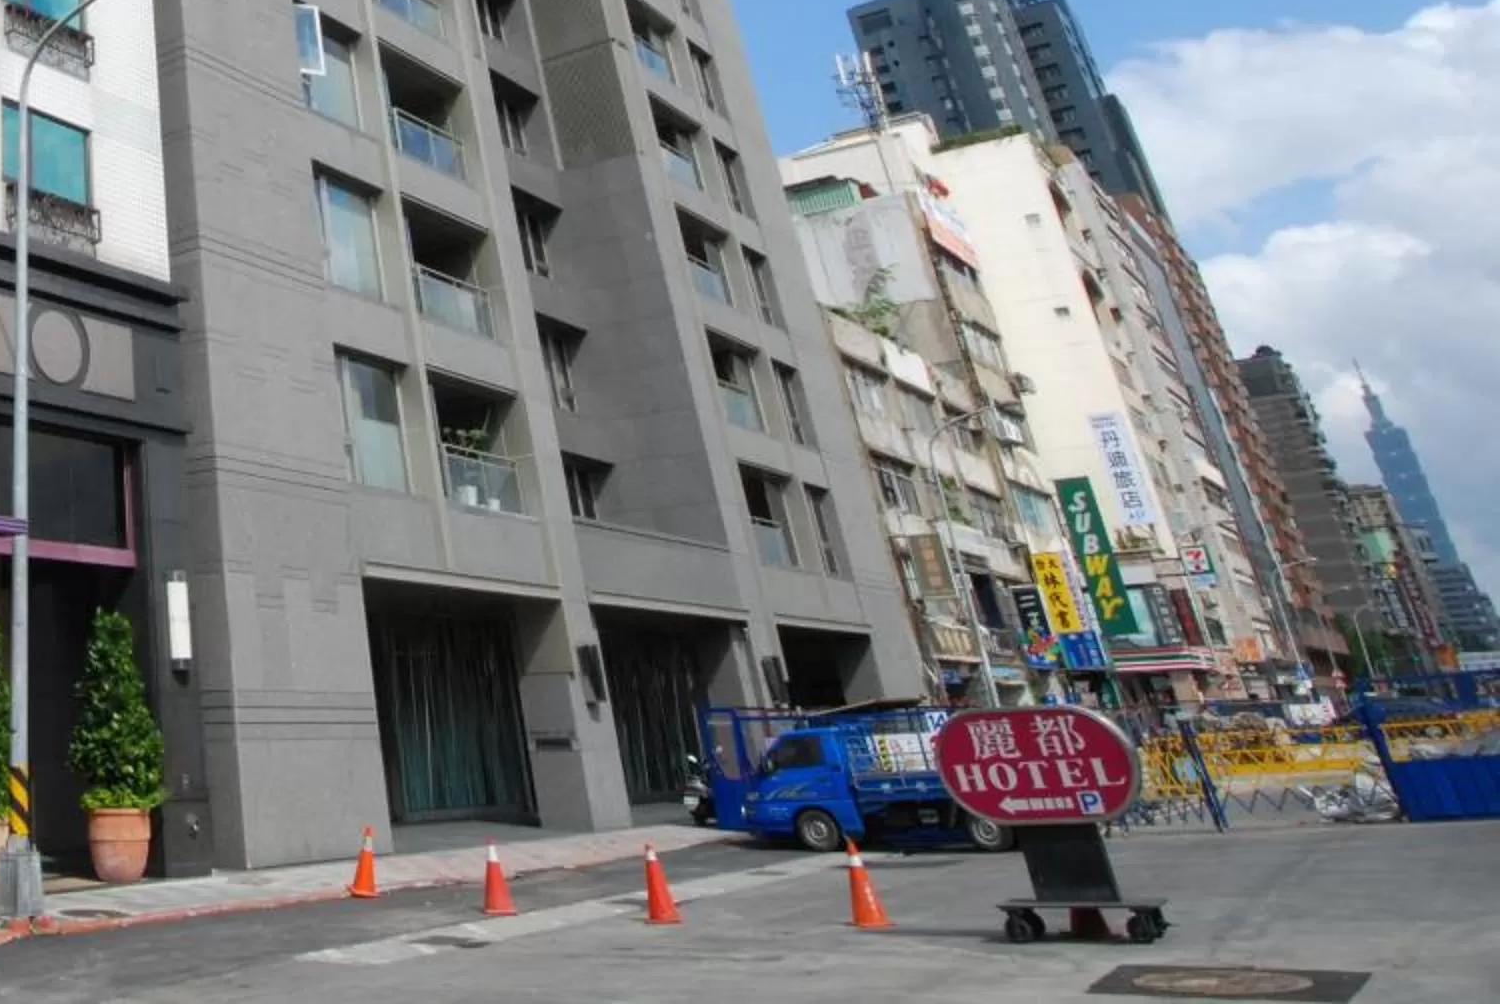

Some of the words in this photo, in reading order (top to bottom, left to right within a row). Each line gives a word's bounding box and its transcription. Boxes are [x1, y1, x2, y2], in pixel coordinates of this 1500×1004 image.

[1067, 491, 1125, 620] SUBWAY
[965, 715, 1086, 761] 麗都
[953, 757, 1127, 793] HOTEL
[1079, 793, 1099, 813] P
